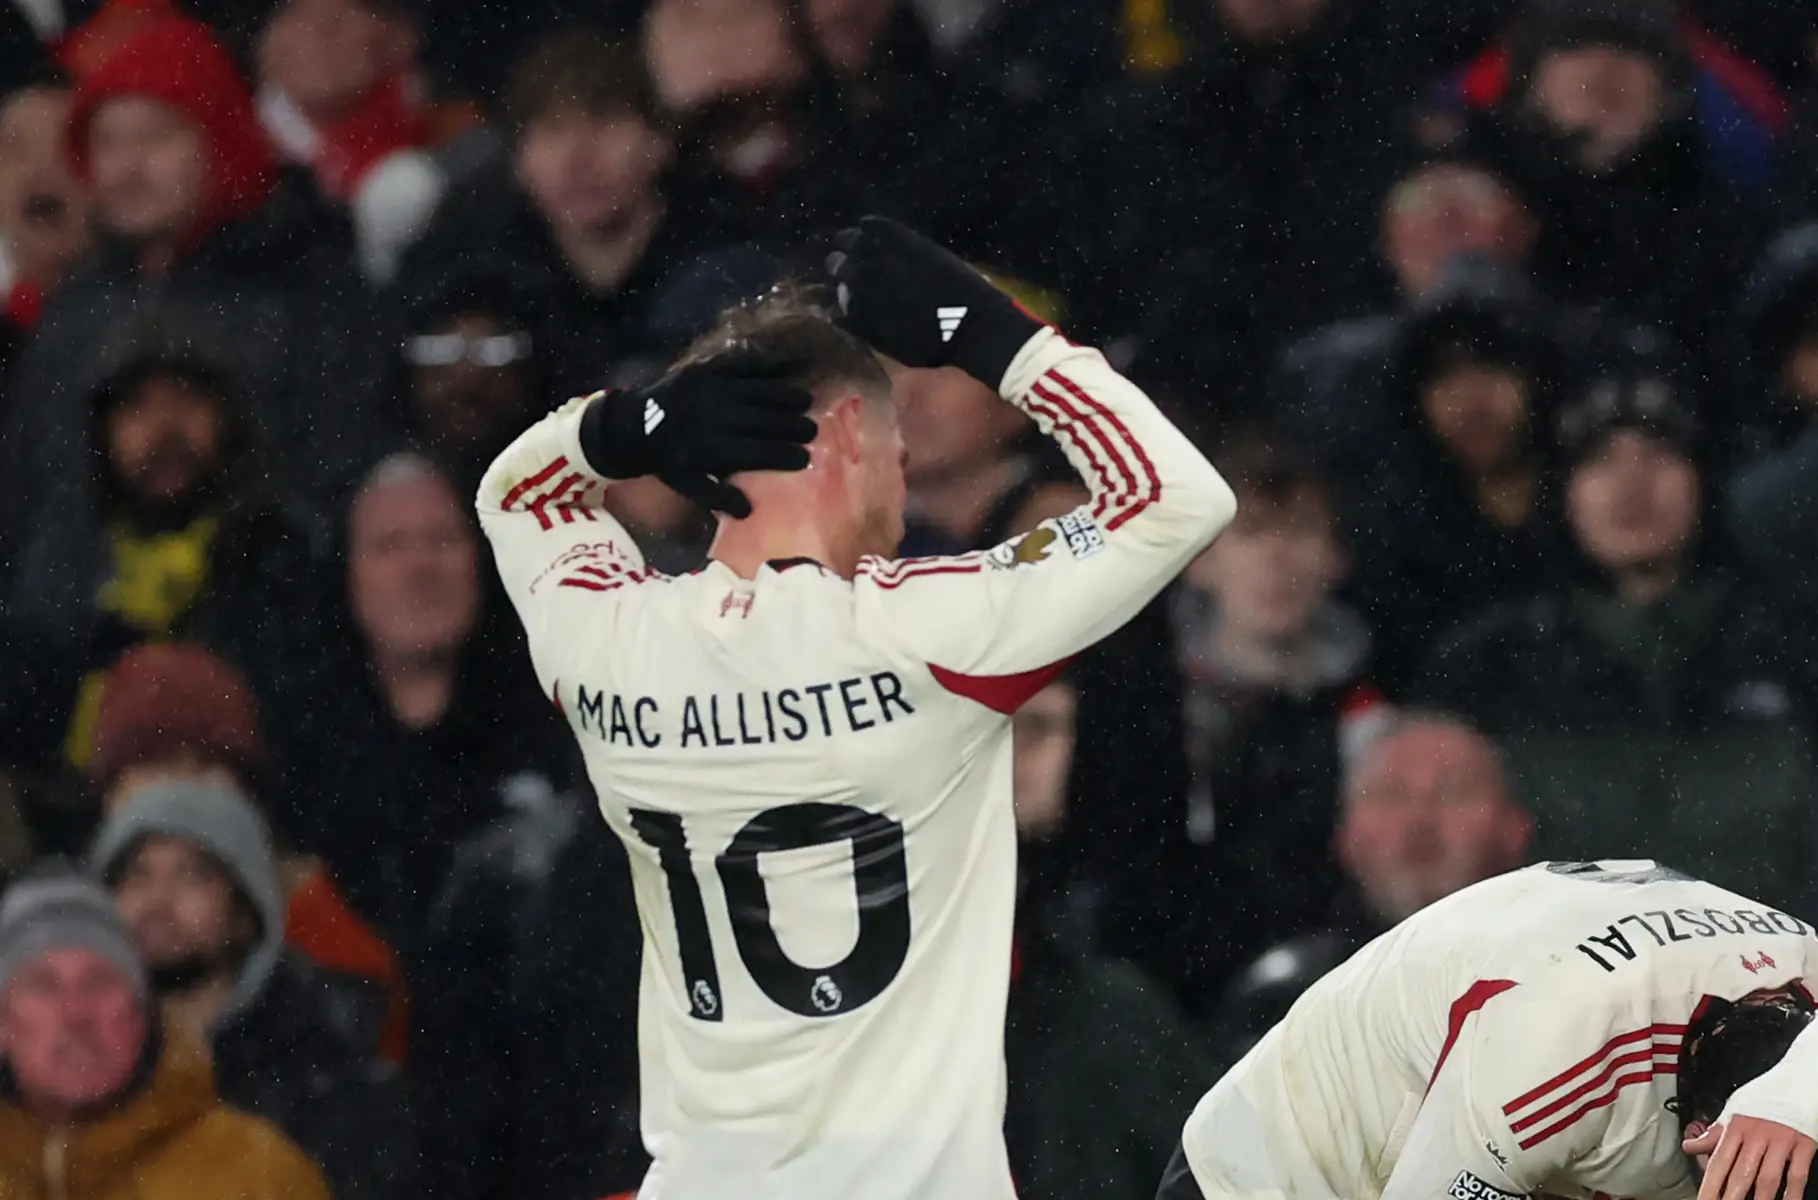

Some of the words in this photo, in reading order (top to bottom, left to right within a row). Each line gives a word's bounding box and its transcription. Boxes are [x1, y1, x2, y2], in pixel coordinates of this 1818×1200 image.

[577, 685, 662, 748] MAC
[681, 671, 916, 747] ALLISTER
[627, 802, 911, 1022] 10
[1457, 1171, 1482, 1192] No
